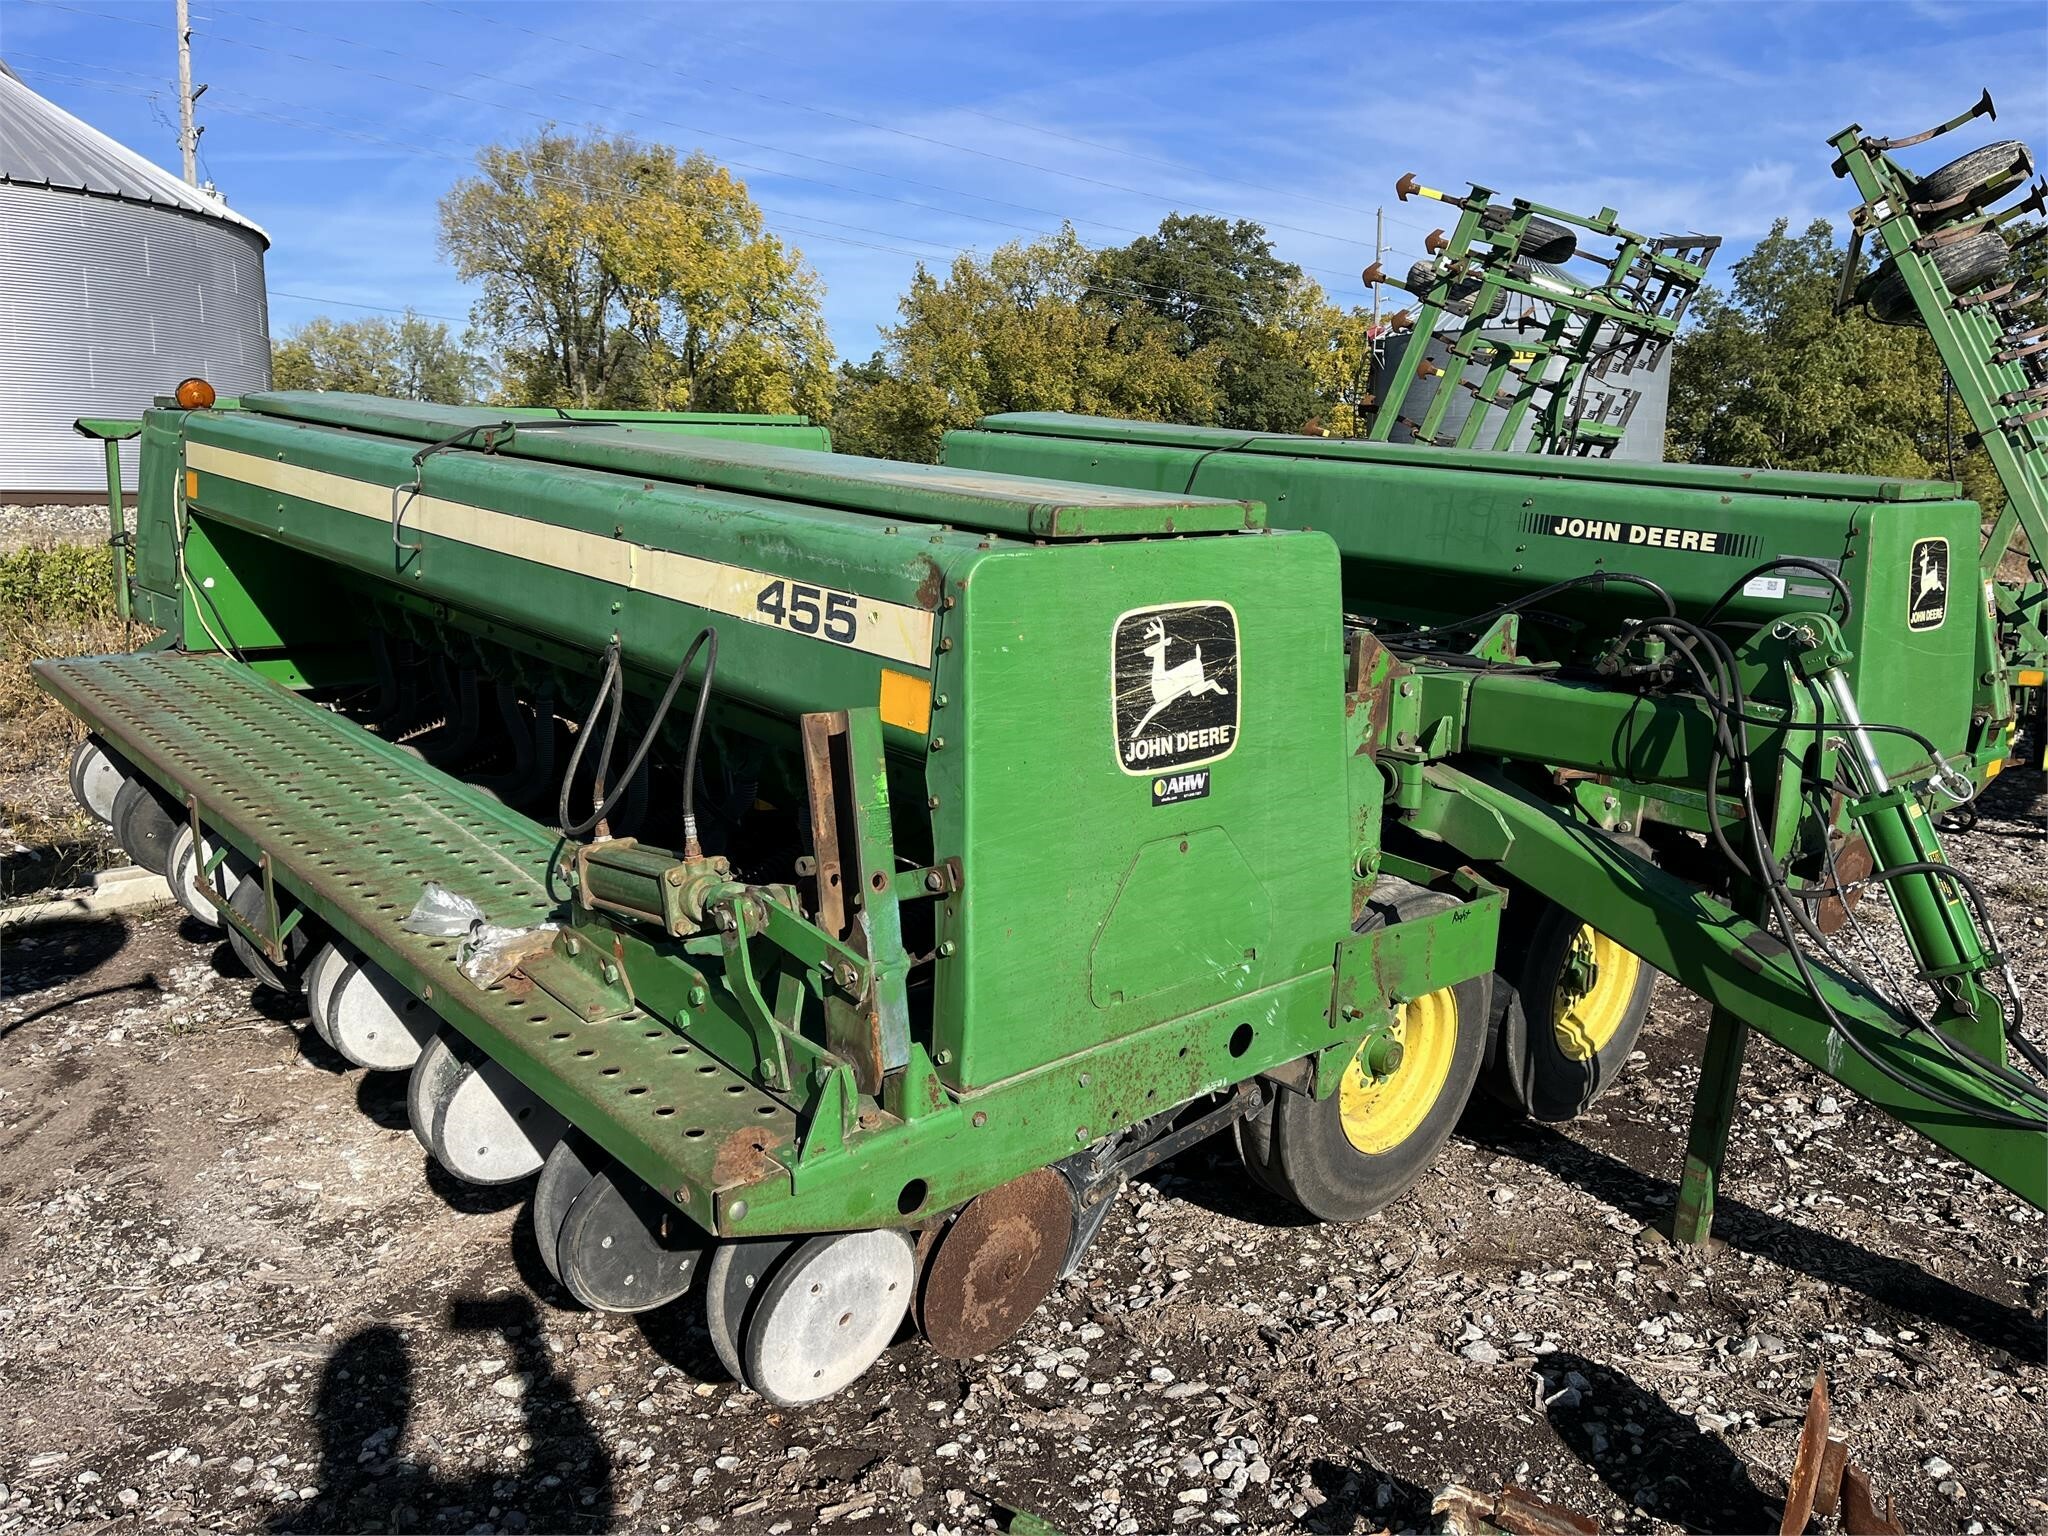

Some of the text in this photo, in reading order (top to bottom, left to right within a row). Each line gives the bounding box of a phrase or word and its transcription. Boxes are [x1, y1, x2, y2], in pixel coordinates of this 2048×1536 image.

[1554, 517, 1718, 552] JOHN DEERE
[756, 580, 857, 644] 455
[1910, 608, 1943, 624] JOHN DEERE
[1125, 725, 1230, 762] JOHN DEERE
[1166, 772, 1206, 795] AHW
